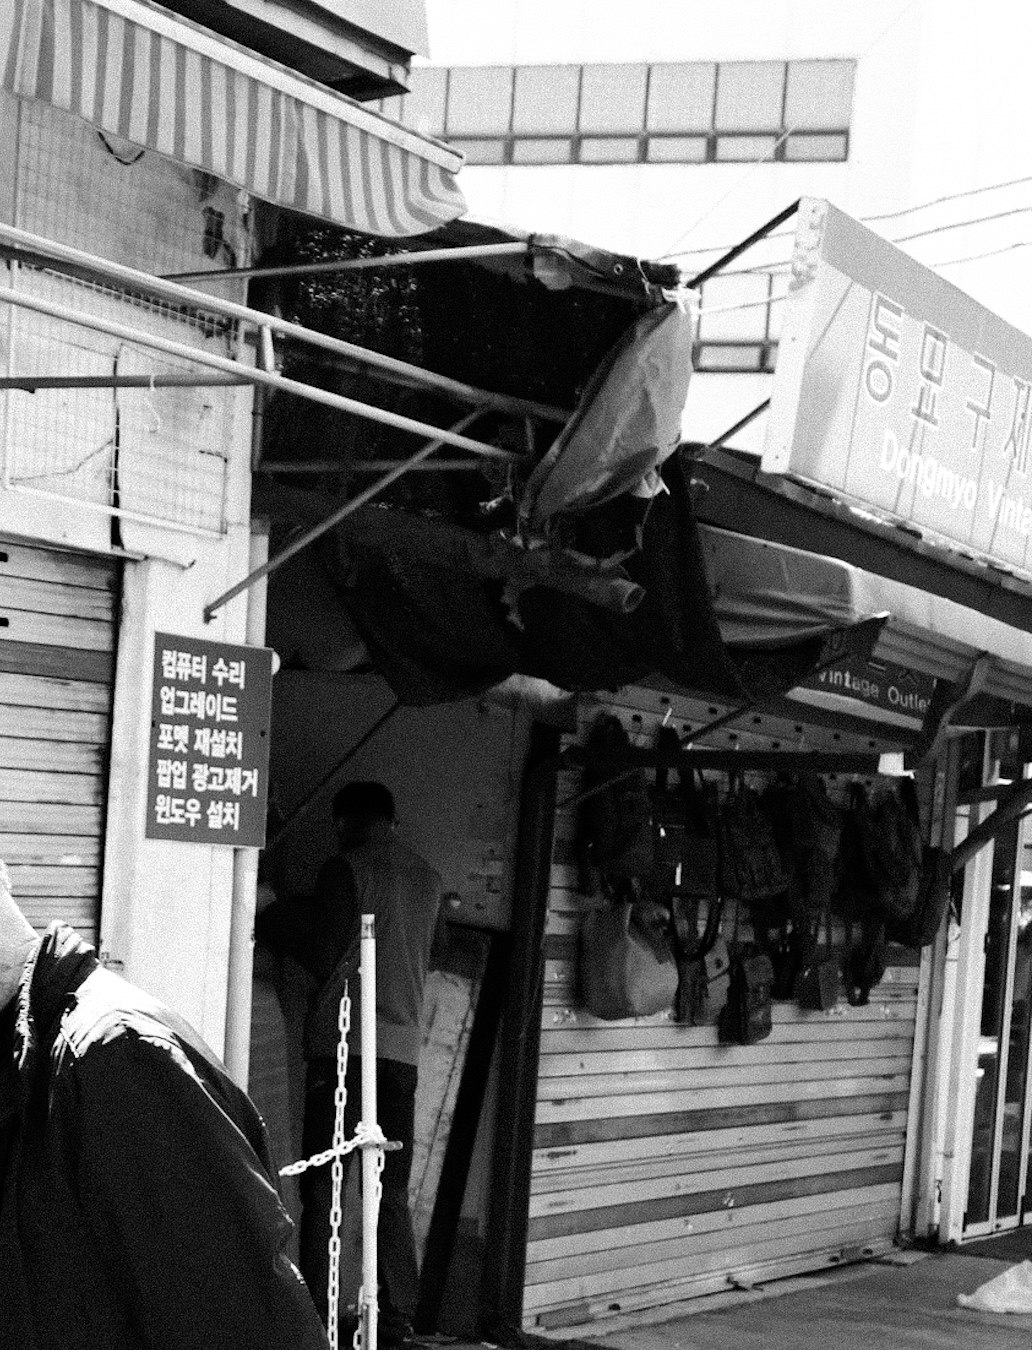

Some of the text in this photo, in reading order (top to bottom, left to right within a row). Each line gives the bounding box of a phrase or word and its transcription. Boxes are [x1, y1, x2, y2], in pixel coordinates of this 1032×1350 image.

[880, 428, 977, 511] Dongmyo
[161, 649, 245, 690] 컴퓨터 수리
[160, 685, 238, 721] 업그레이드
[888, 685, 931, 712] Outle
[194, 728, 242, 760] 재설치
[157, 759, 258, 797] 팝업 광고제거
[155, 794, 239, 830] 윈도우 설치
